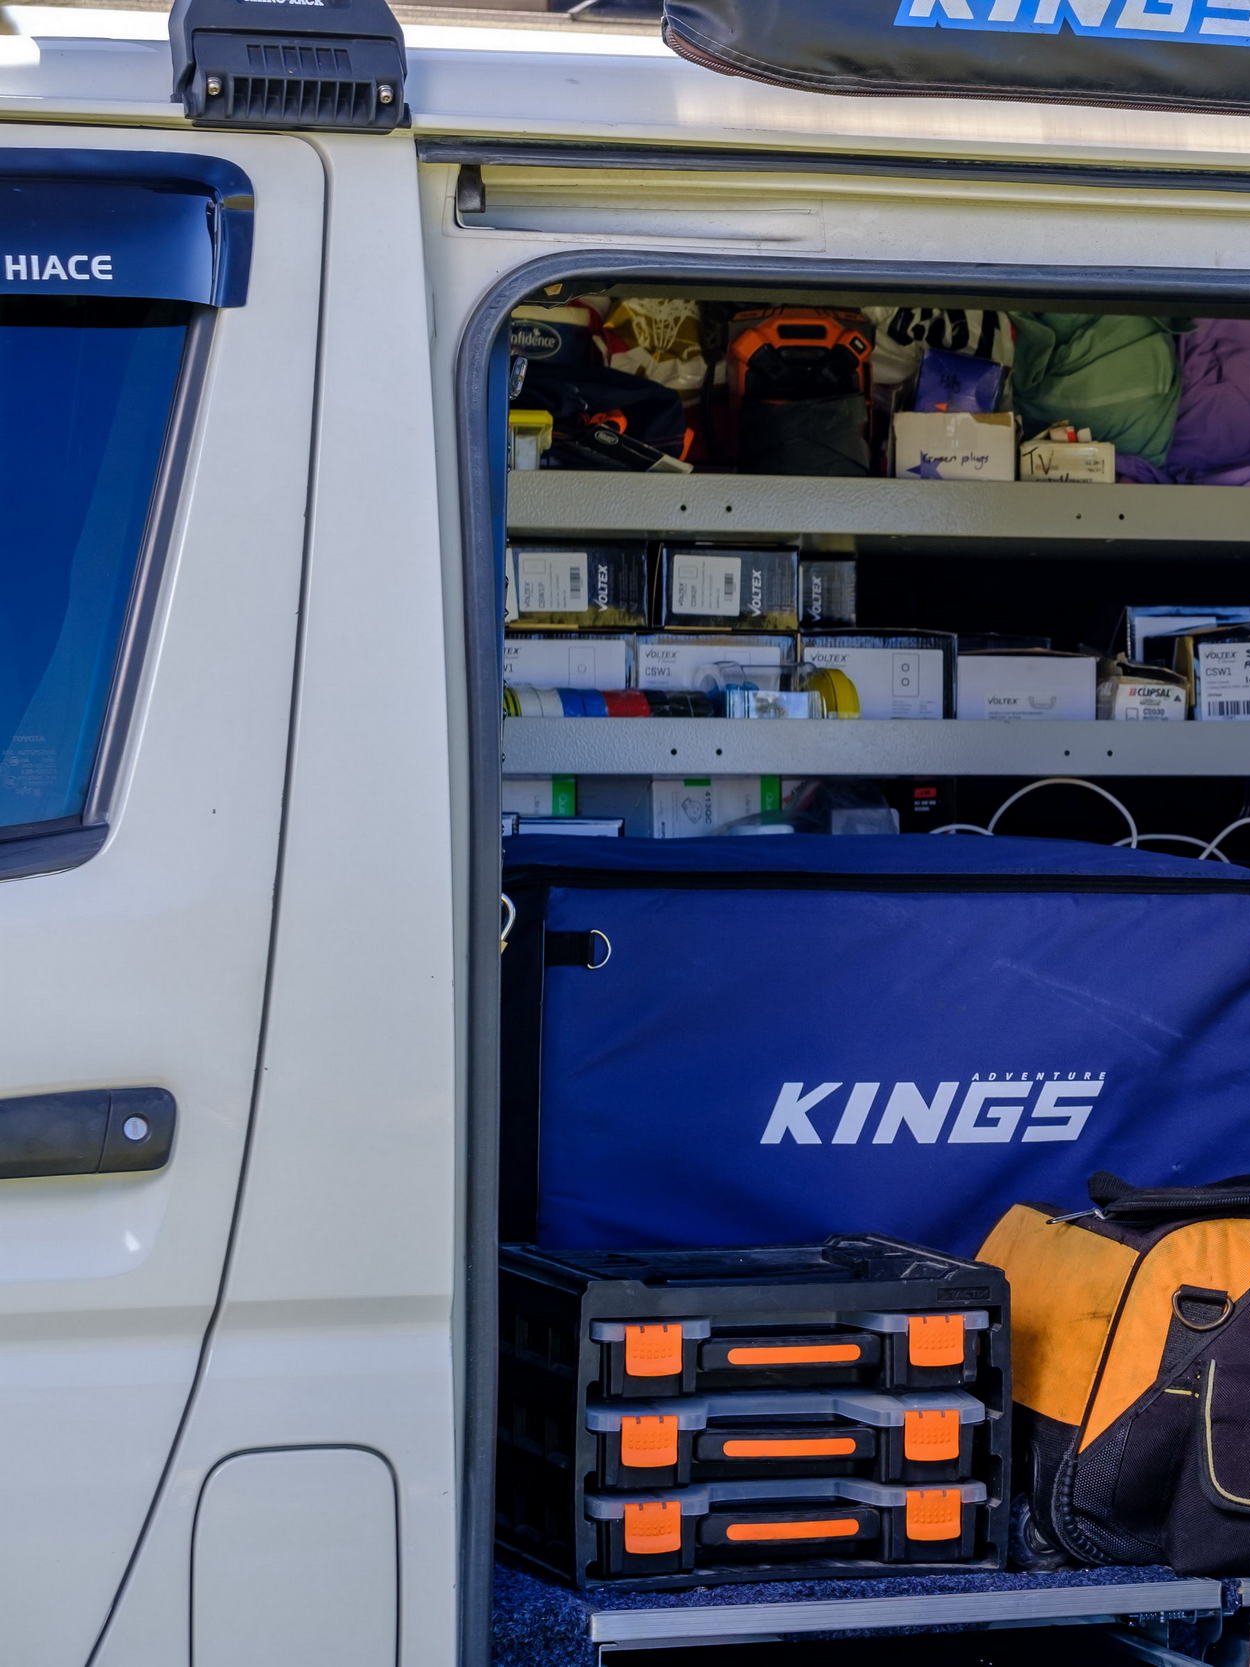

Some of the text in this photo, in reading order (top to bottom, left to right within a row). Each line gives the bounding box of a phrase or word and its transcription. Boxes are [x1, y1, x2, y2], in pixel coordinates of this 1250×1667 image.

[5, 254, 113, 281] HIACE
[595, 564, 608, 612] VOLTEX
[748, 569, 762, 617] VOLTEX
[808, 576, 822, 622] VOLTEX
[644, 649, 677, 659] VOLTEX
[810, 653, 849, 663] VOLTEX
[1204, 652, 1237, 660] VOLTEX
[645, 667, 671, 677] CSW1
[1205, 667, 1232, 676] CSW1
[1137, 688, 1170, 698] CLIPSAL
[988, 697, 1018, 705] VOLTEX
[972, 1071, 1107, 1081] ADVENTURE
[759, 1080, 1104, 1144] KINGS
